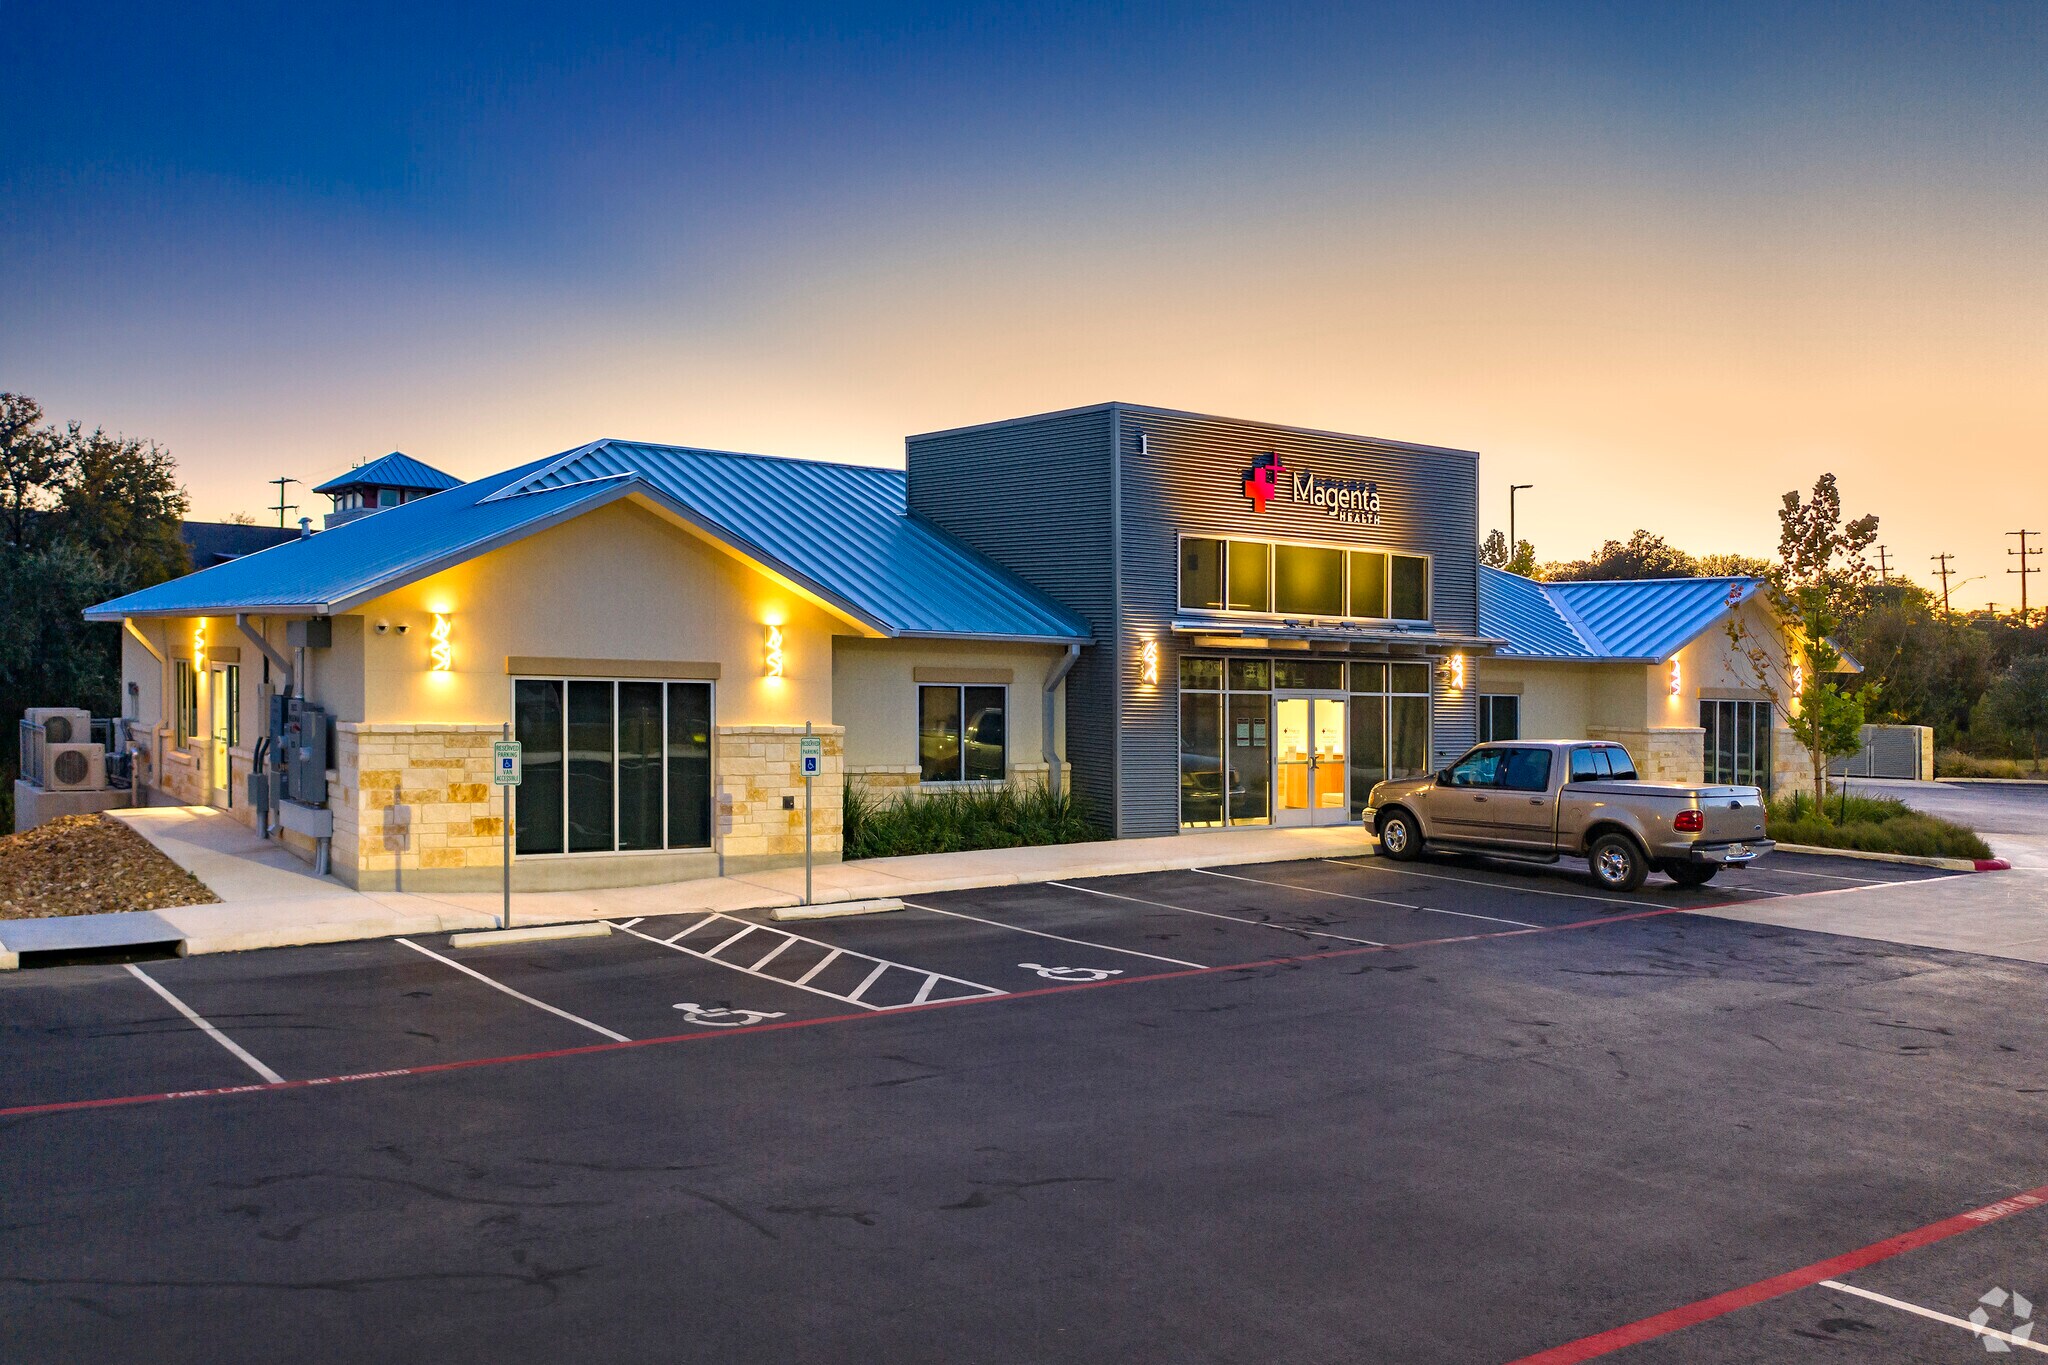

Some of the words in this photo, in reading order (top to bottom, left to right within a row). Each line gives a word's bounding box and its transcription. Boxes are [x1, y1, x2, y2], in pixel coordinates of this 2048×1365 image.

[1293, 470, 1380, 516] Magenta
[1339, 510, 1380, 525] HEALTH
[167, 1090, 206, 1098] FIRE
[217, 1084, 266, 1093] LANE
[339, 1069, 411, 1081] PARKING
